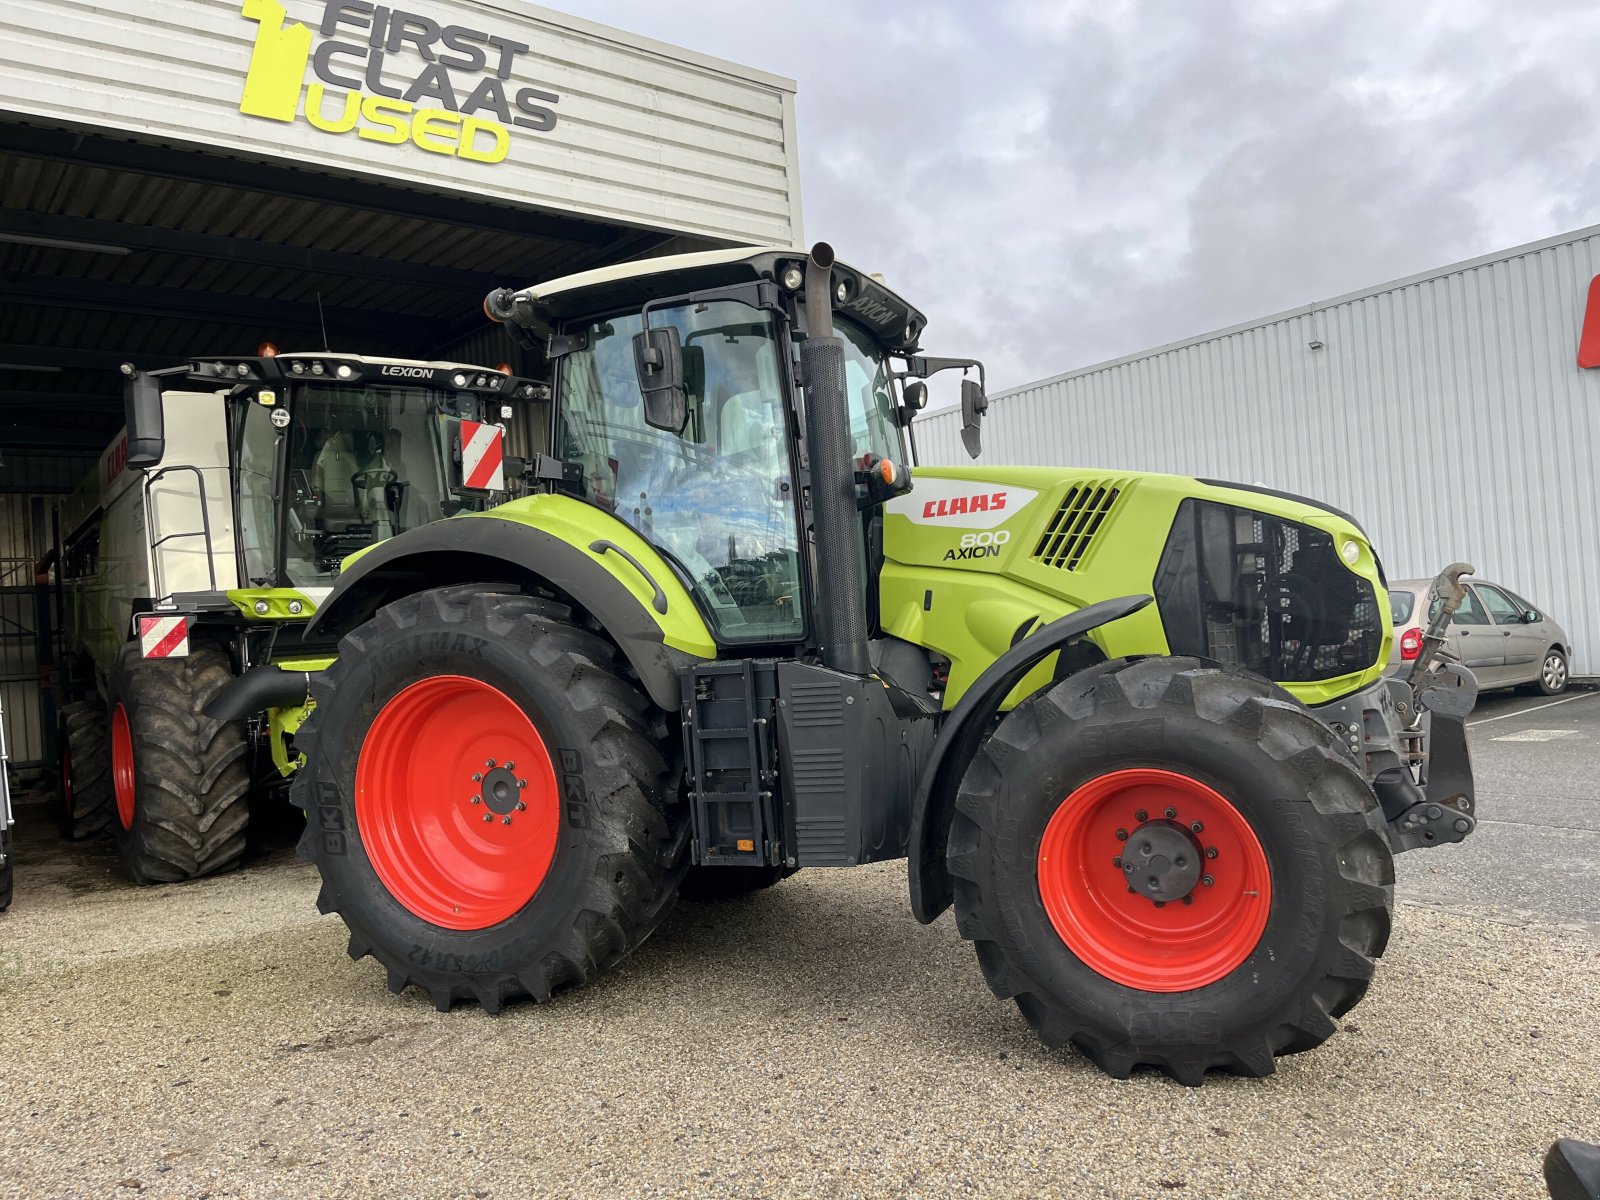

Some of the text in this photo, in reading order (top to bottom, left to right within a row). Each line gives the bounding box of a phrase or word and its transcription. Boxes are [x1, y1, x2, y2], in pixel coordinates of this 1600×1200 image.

[320, 0, 530, 80] FIRST
[313, 40, 559, 132] CLAAS
[304, 82, 511, 164] USED
[847, 296, 898, 325] AXION
[381, 365, 434, 379] LEXION
[922, 492, 1007, 519] CLAAS
[943, 545, 1000, 561] AXION
[960, 530, 1011, 548] 800
[558, 748, 592, 829] BKT
[315, 781, 347, 856] BKT
